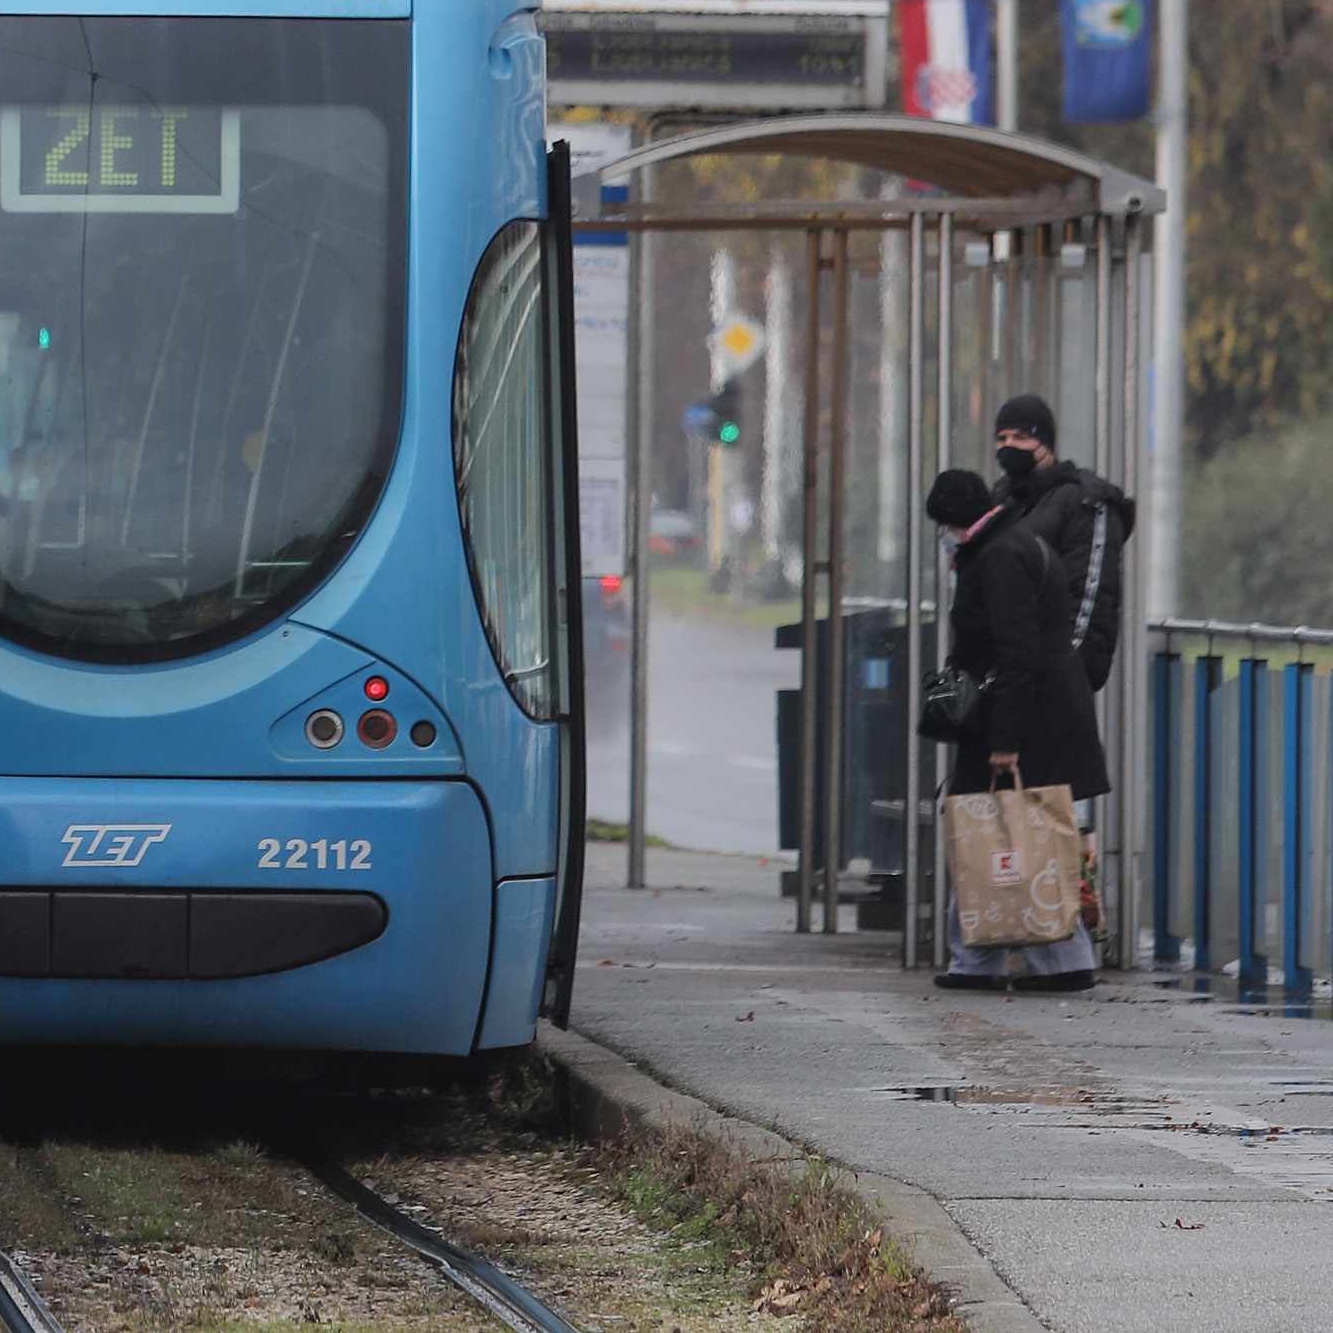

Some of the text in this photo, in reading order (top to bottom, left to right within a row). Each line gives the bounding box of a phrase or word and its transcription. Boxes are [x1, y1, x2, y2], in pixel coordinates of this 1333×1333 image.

[45, 106, 188, 187] ZET
[61, 824, 172, 867] ZET
[257, 838, 372, 869] 22112
